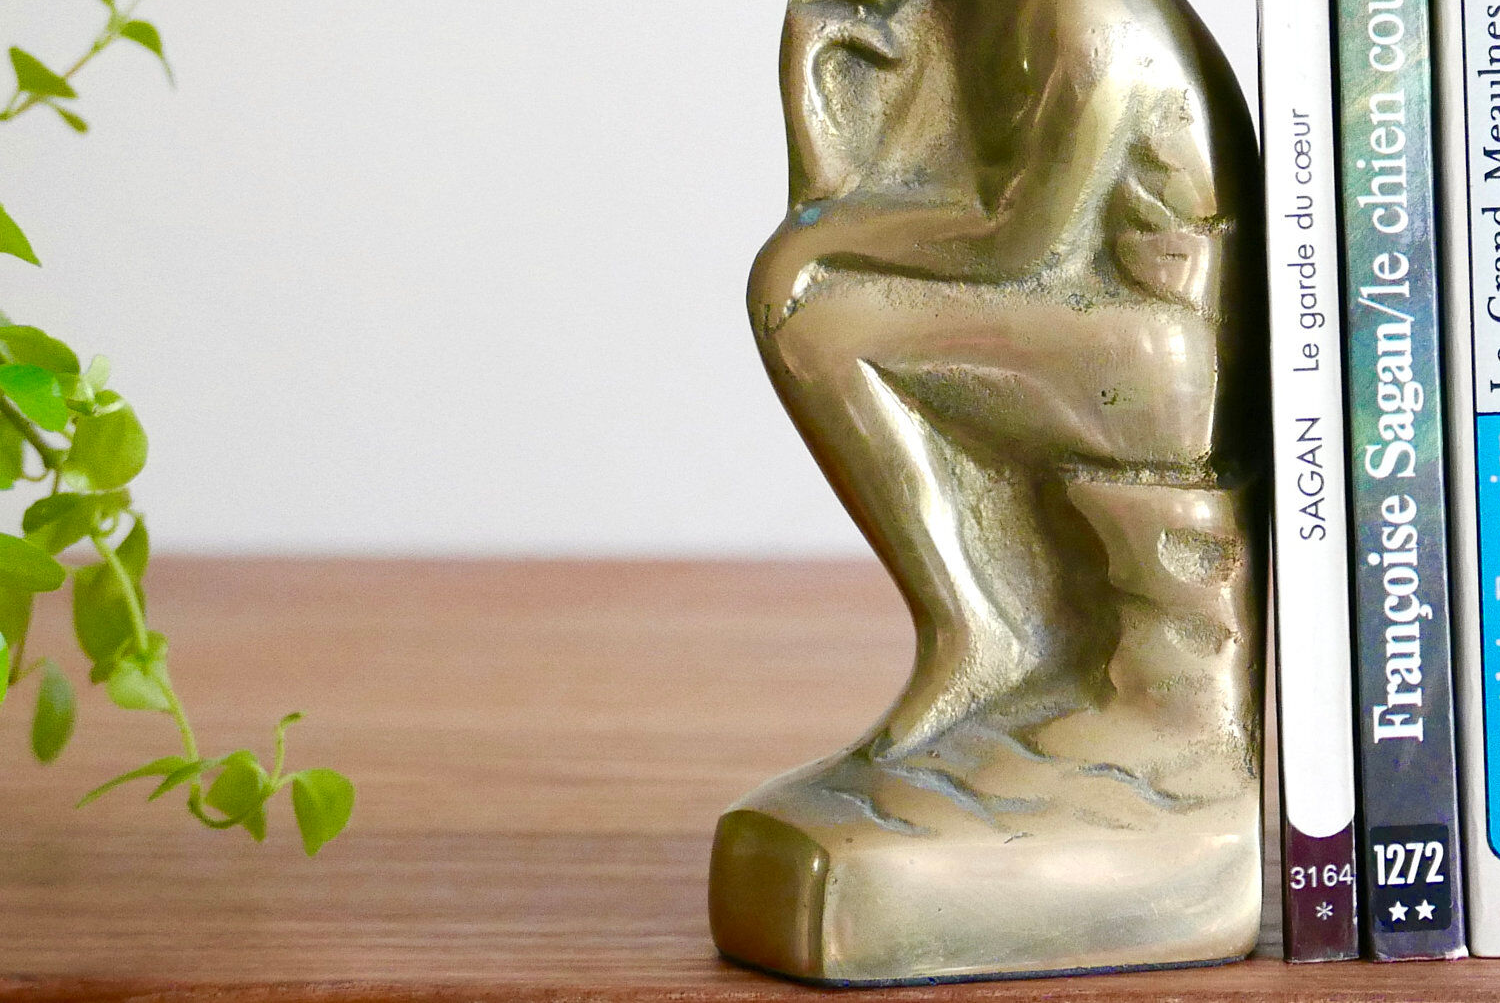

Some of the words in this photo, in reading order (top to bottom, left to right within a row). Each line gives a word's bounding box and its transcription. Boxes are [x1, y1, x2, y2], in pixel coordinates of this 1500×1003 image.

[1292, 108, 1312, 185] cœur
[1356, 89, 1409, 234] chien
[1285, 195, 1314, 230] du
[1287, 243, 1325, 329] garde
[1293, 343, 1320, 372] Le
[1357, 252, 1423, 479] Sagan/le
[1296, 417, 1325, 540] SAGAN
[1368, 494, 1432, 744] Françoise
[1290, 863, 1353, 890] 3164
[1373, 841, 1444, 886] 1272
